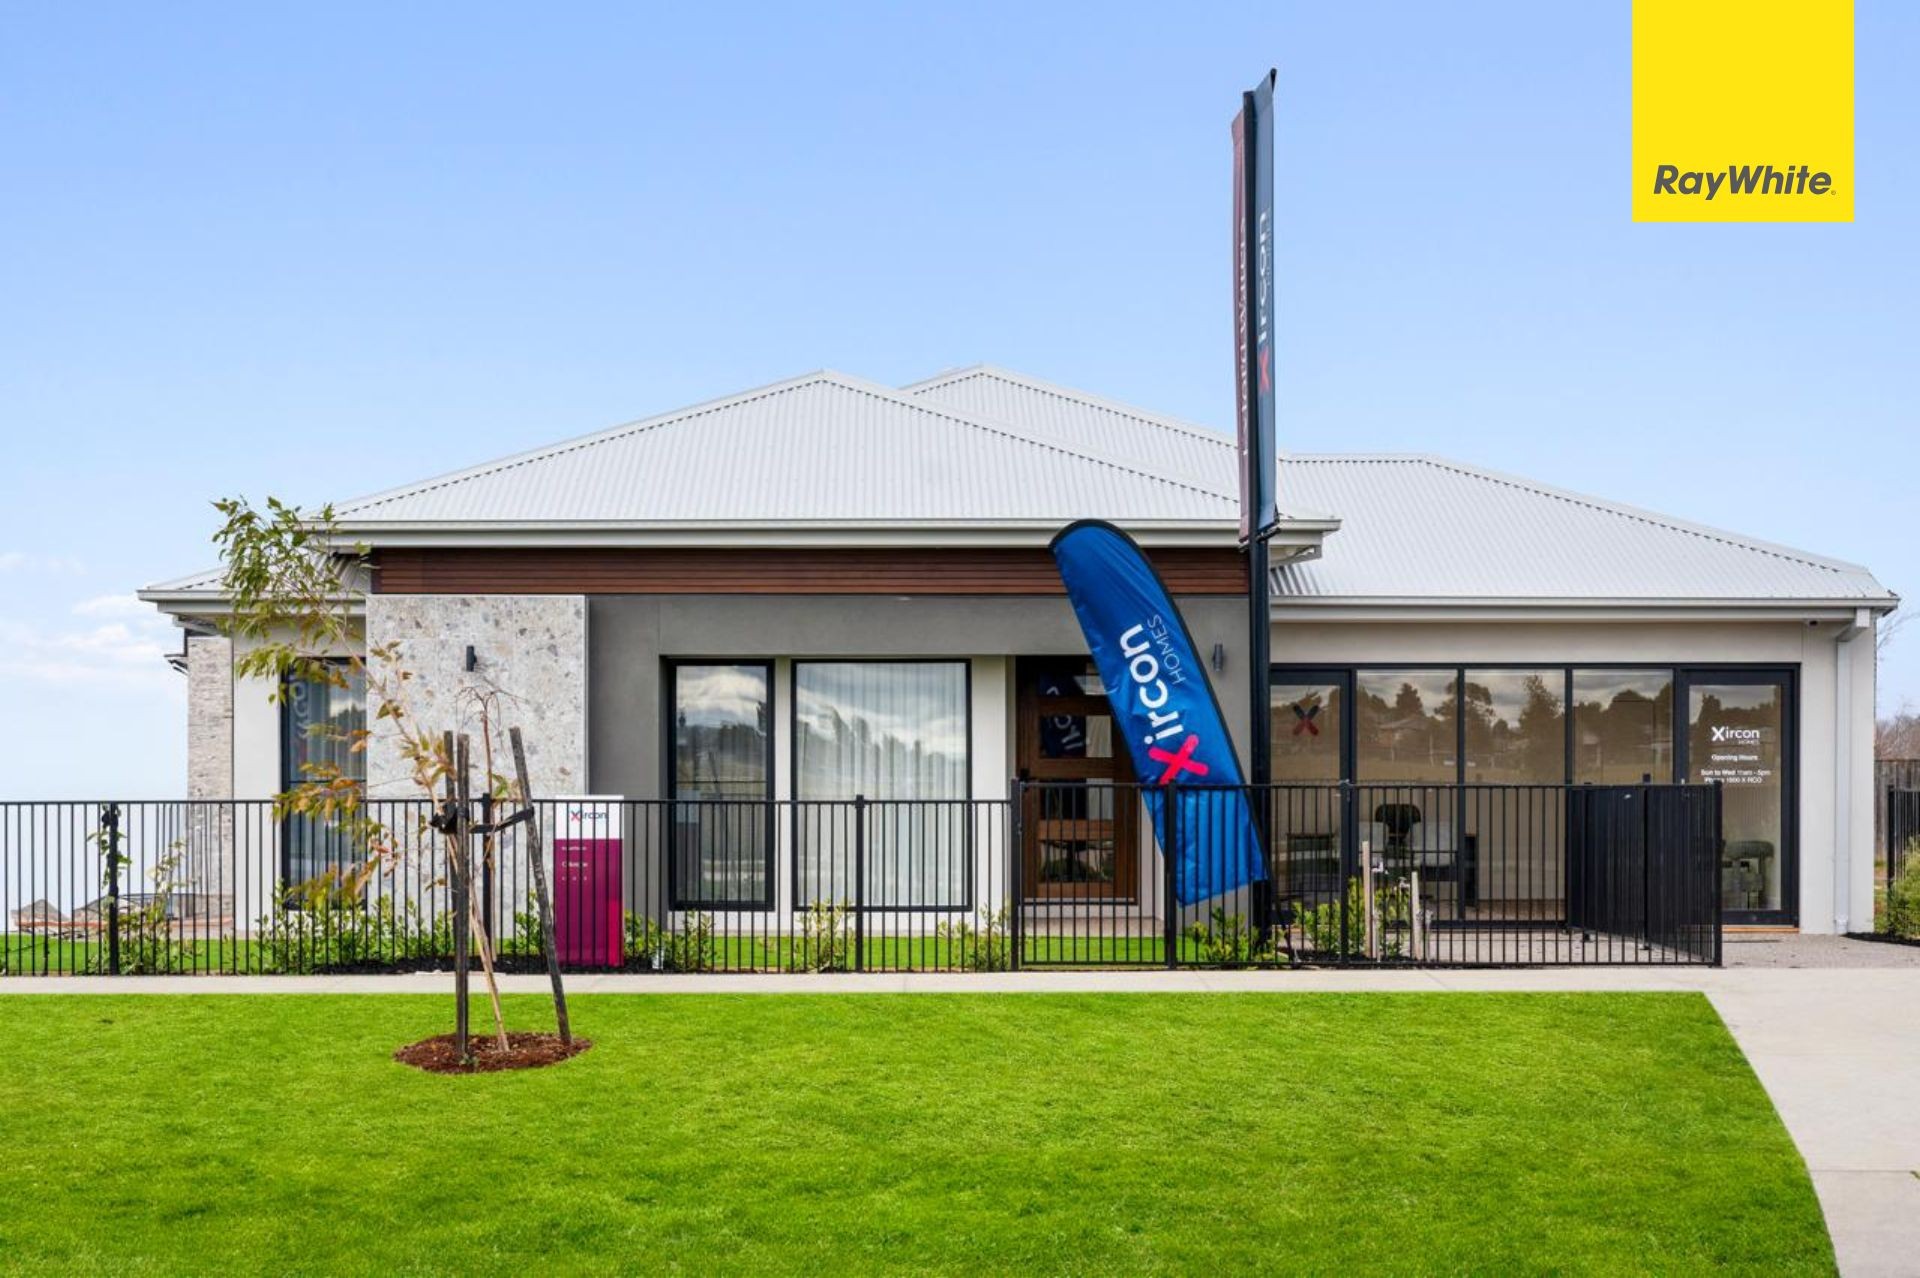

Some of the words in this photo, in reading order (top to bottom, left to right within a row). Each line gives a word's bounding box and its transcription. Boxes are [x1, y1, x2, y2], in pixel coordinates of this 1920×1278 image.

[1147, 614, 1186, 685] HOMES
[1120, 624, 1209, 785] Xircon
[1711, 726, 1760, 741] Xircon
